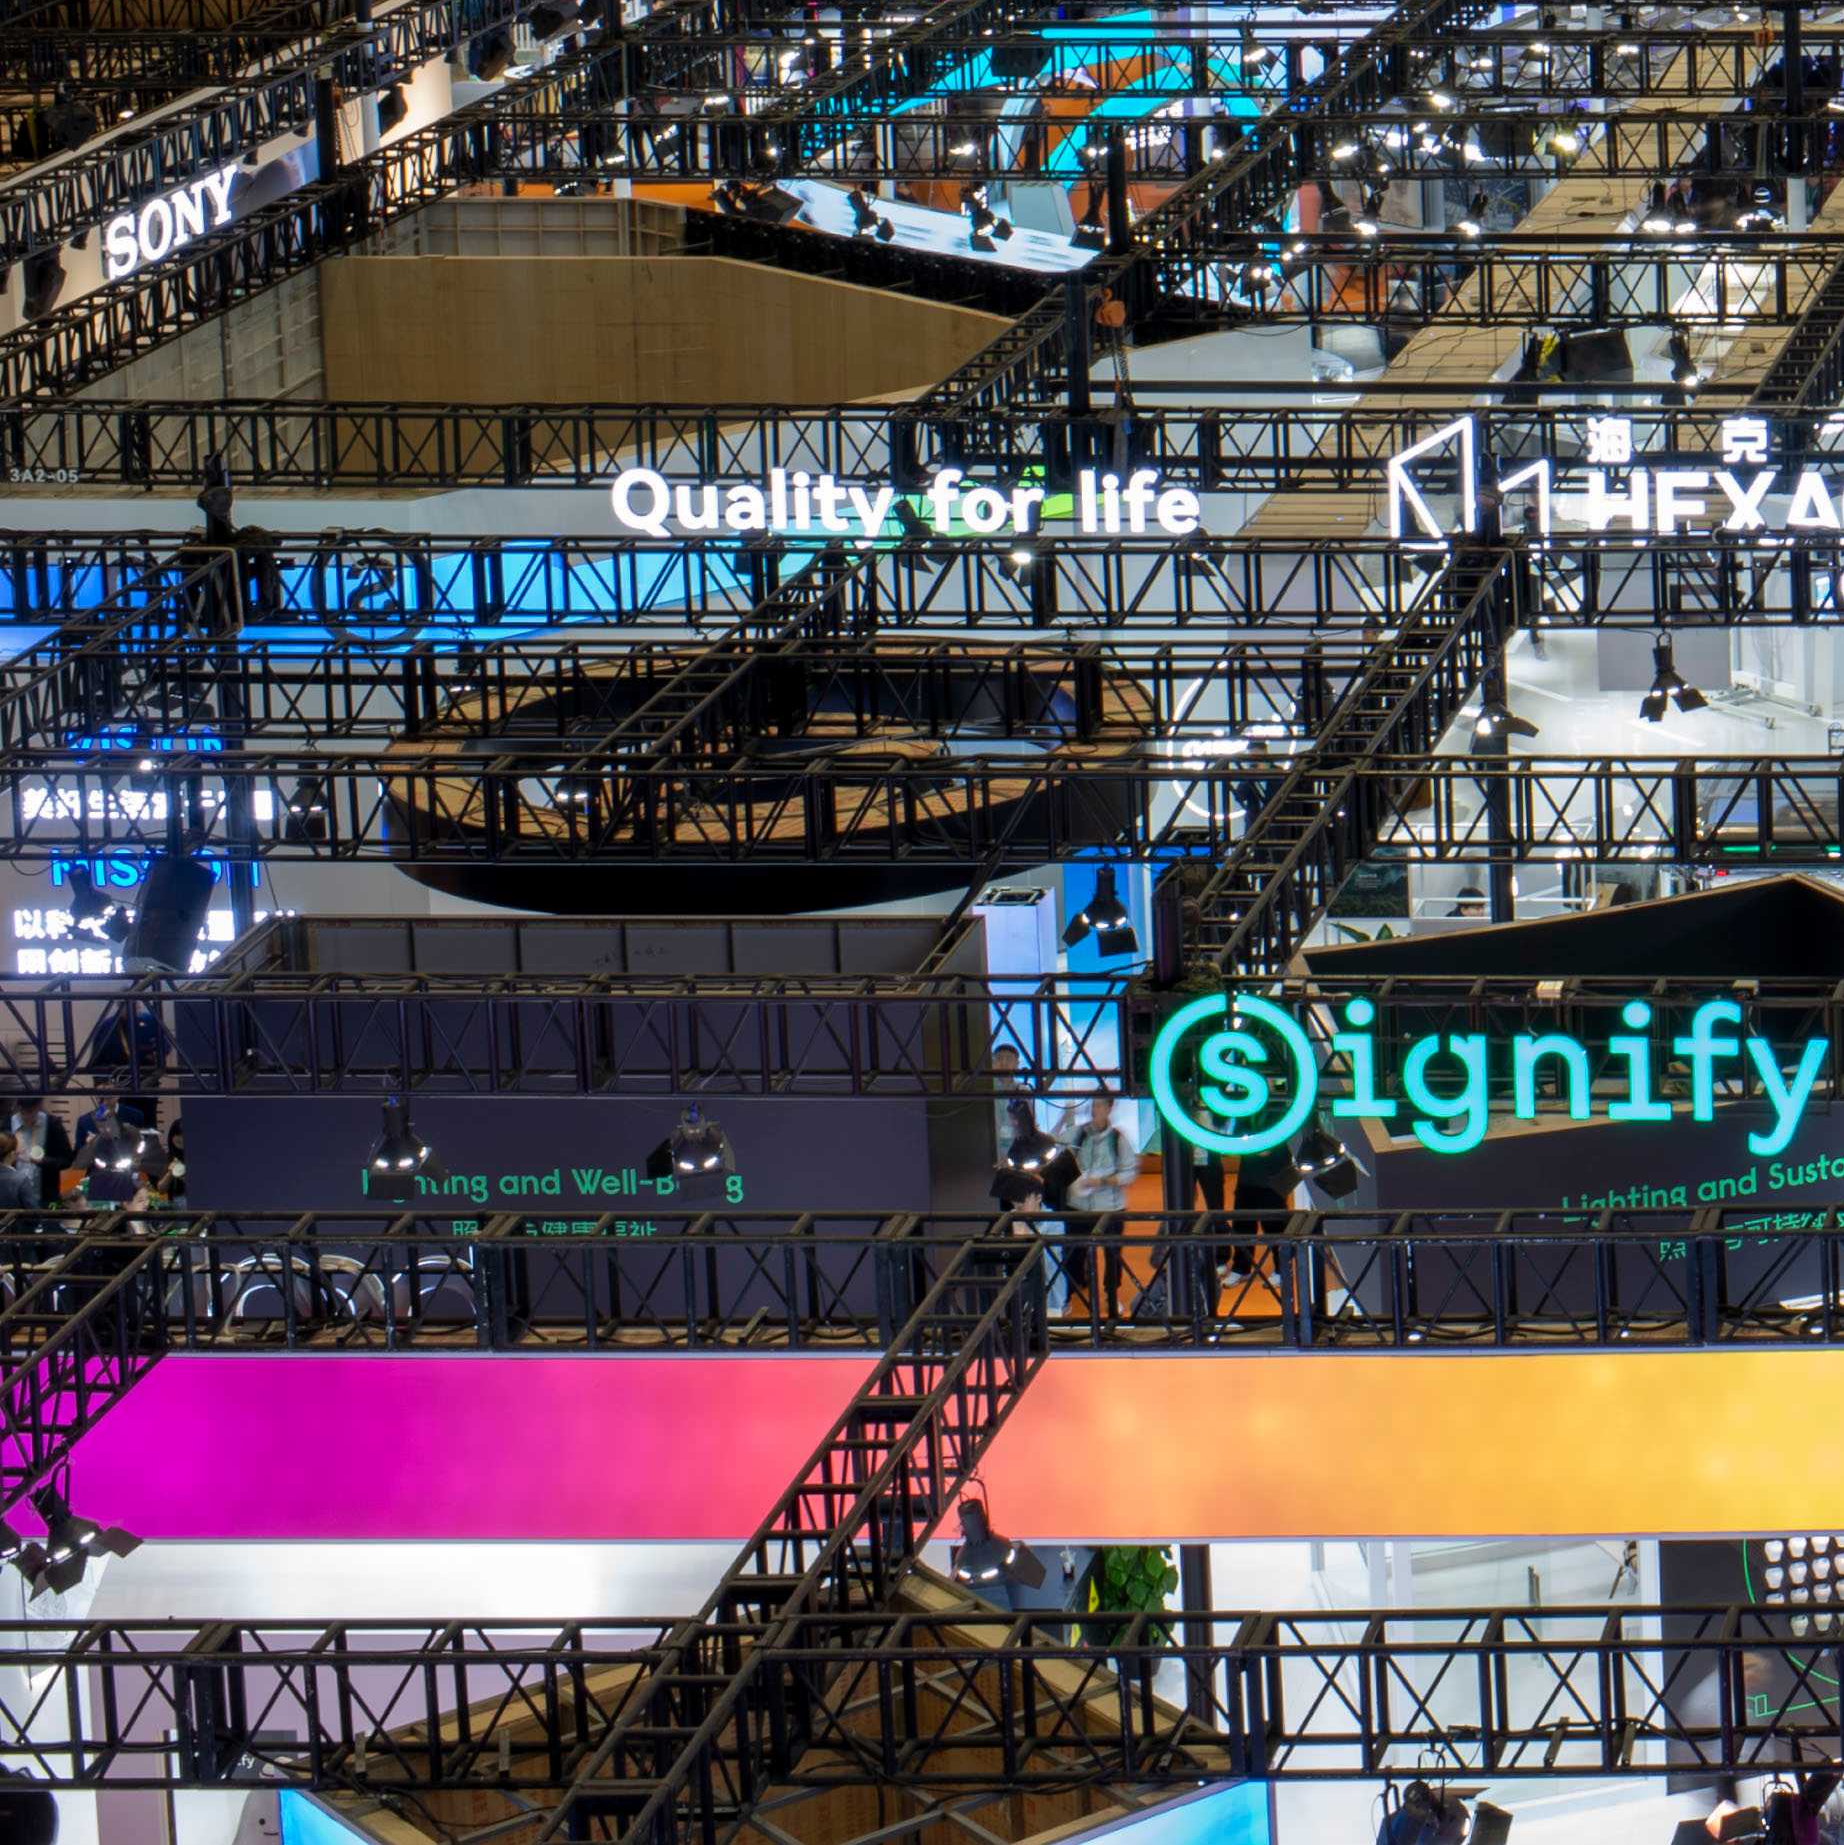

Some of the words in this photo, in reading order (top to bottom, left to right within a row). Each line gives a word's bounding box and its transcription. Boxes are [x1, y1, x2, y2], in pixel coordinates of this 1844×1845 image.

[105, 164, 239, 279] SONY
[611, 467, 894, 550] Quality
[927, 467, 1046, 534] for
[1079, 468, 1202, 535] life
[500, 1169, 561, 1195] and
[1698, 1166, 1758, 1201] and
